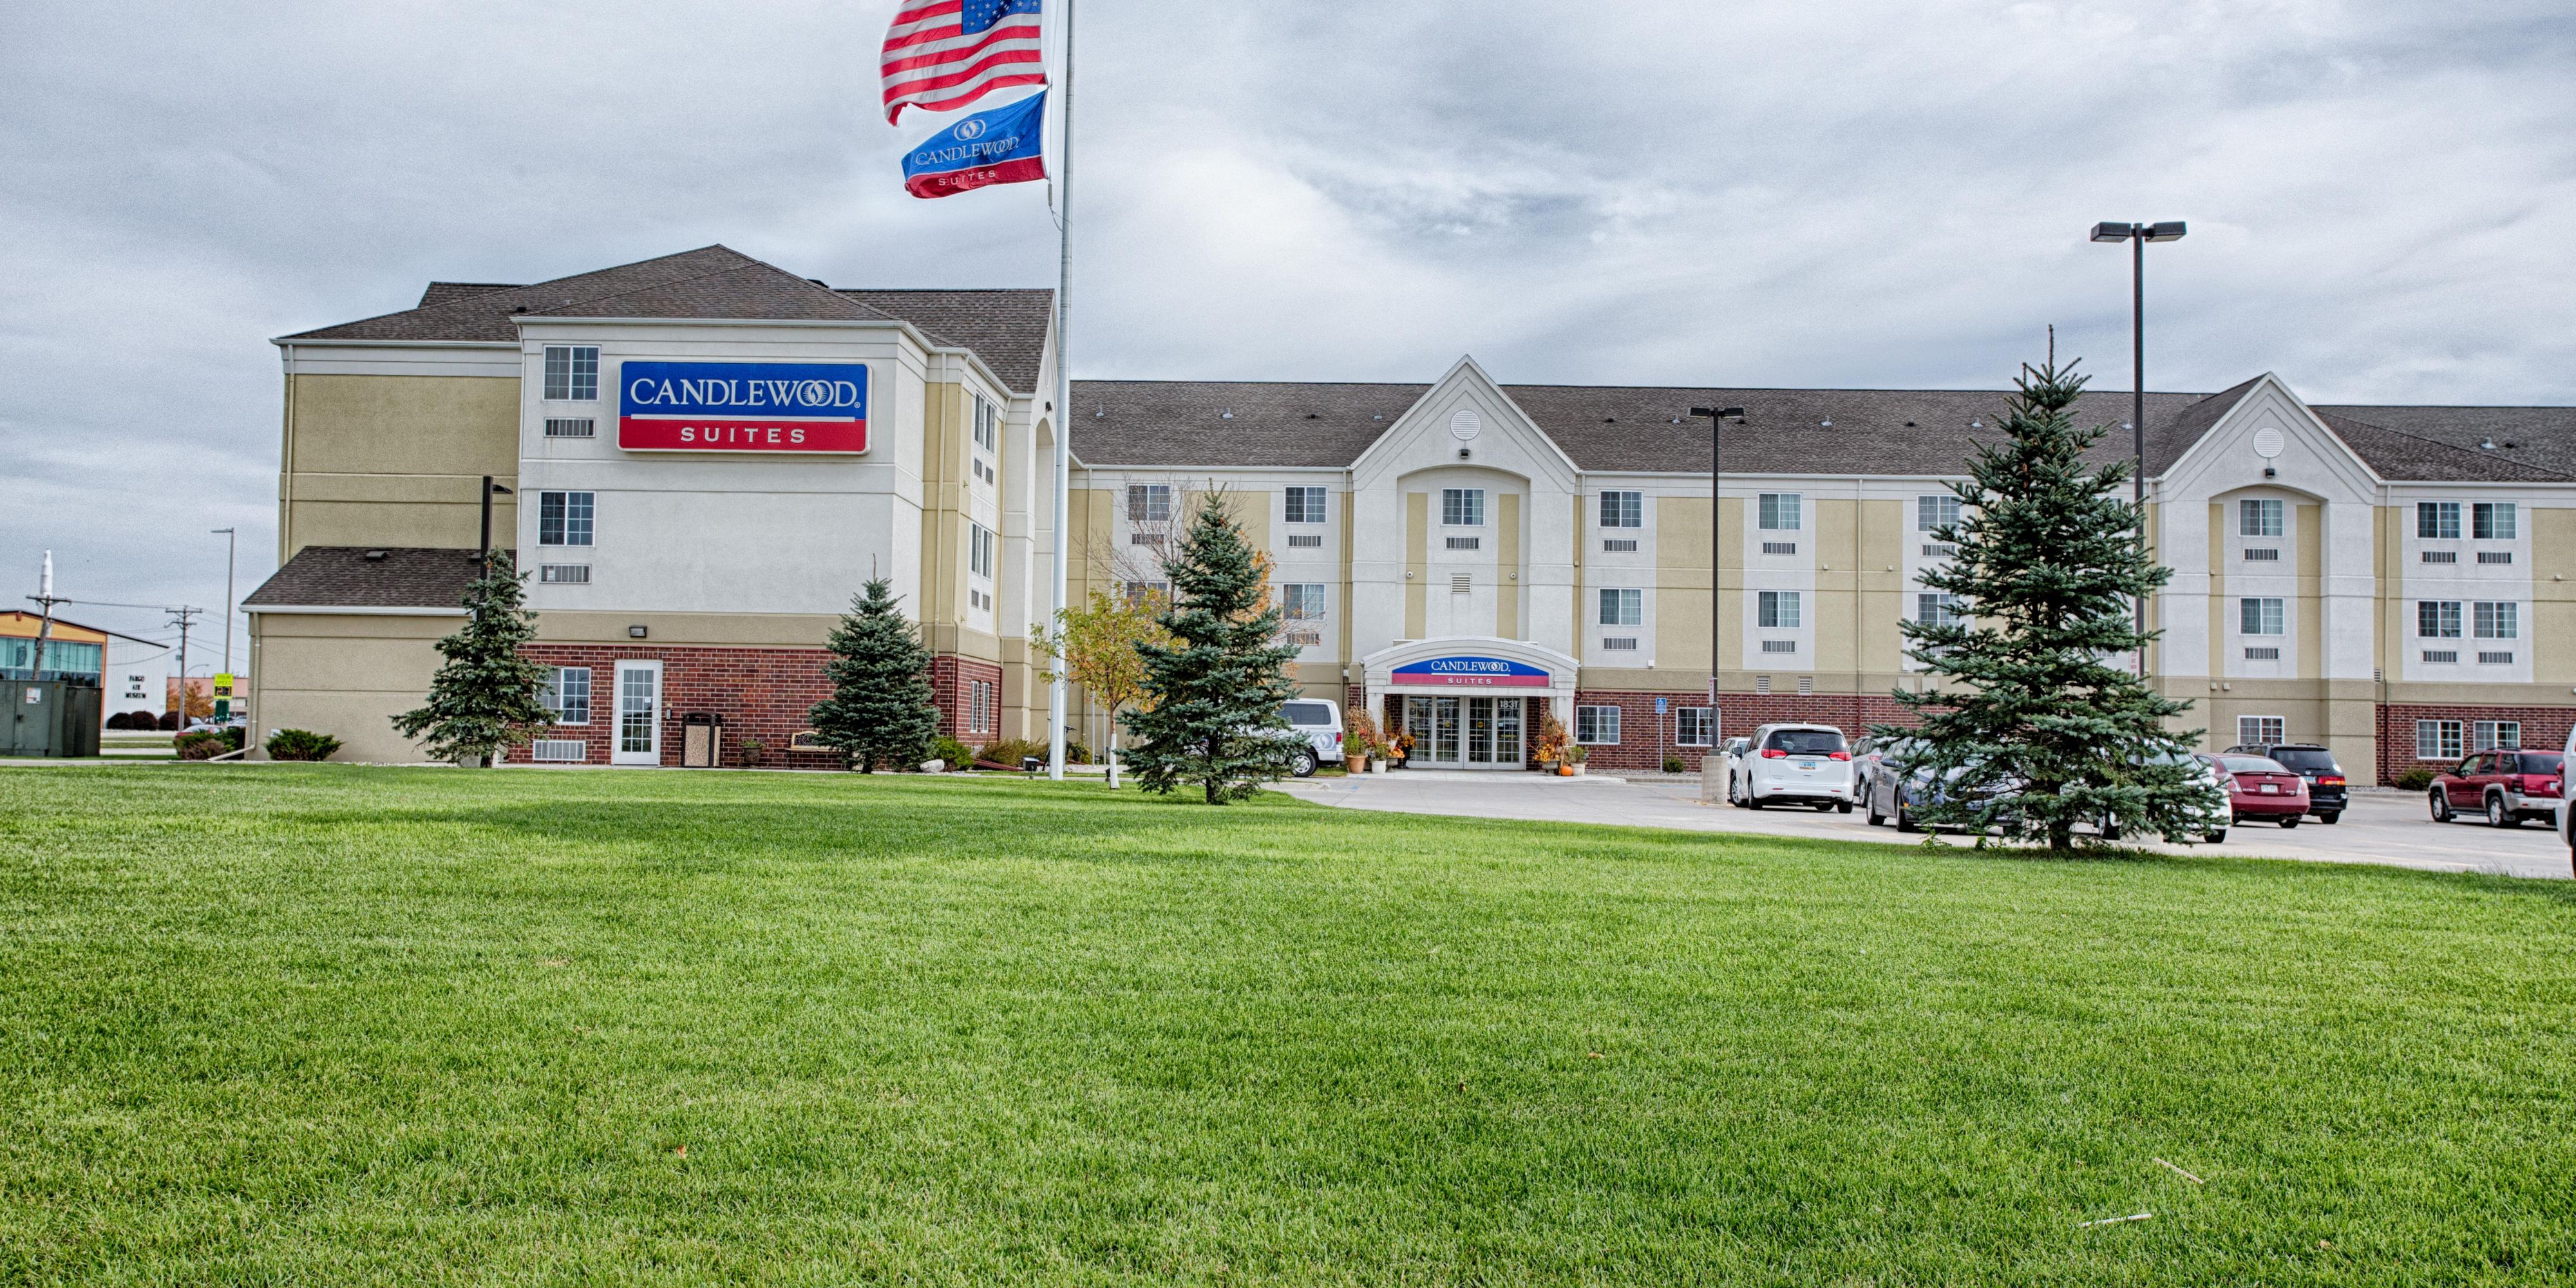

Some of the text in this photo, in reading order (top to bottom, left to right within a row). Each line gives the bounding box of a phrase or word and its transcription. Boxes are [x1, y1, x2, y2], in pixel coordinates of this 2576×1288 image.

[915, 137, 1019, 166] CANDLEWOOD
[938, 170, 996, 185] SUITES
[630, 377, 858, 407] CANDLEWOOD
[680, 427, 805, 443] SUITES
[1431, 661, 1510, 672] CANDLEWOOD
[1499, 700, 1518, 708] 1831
